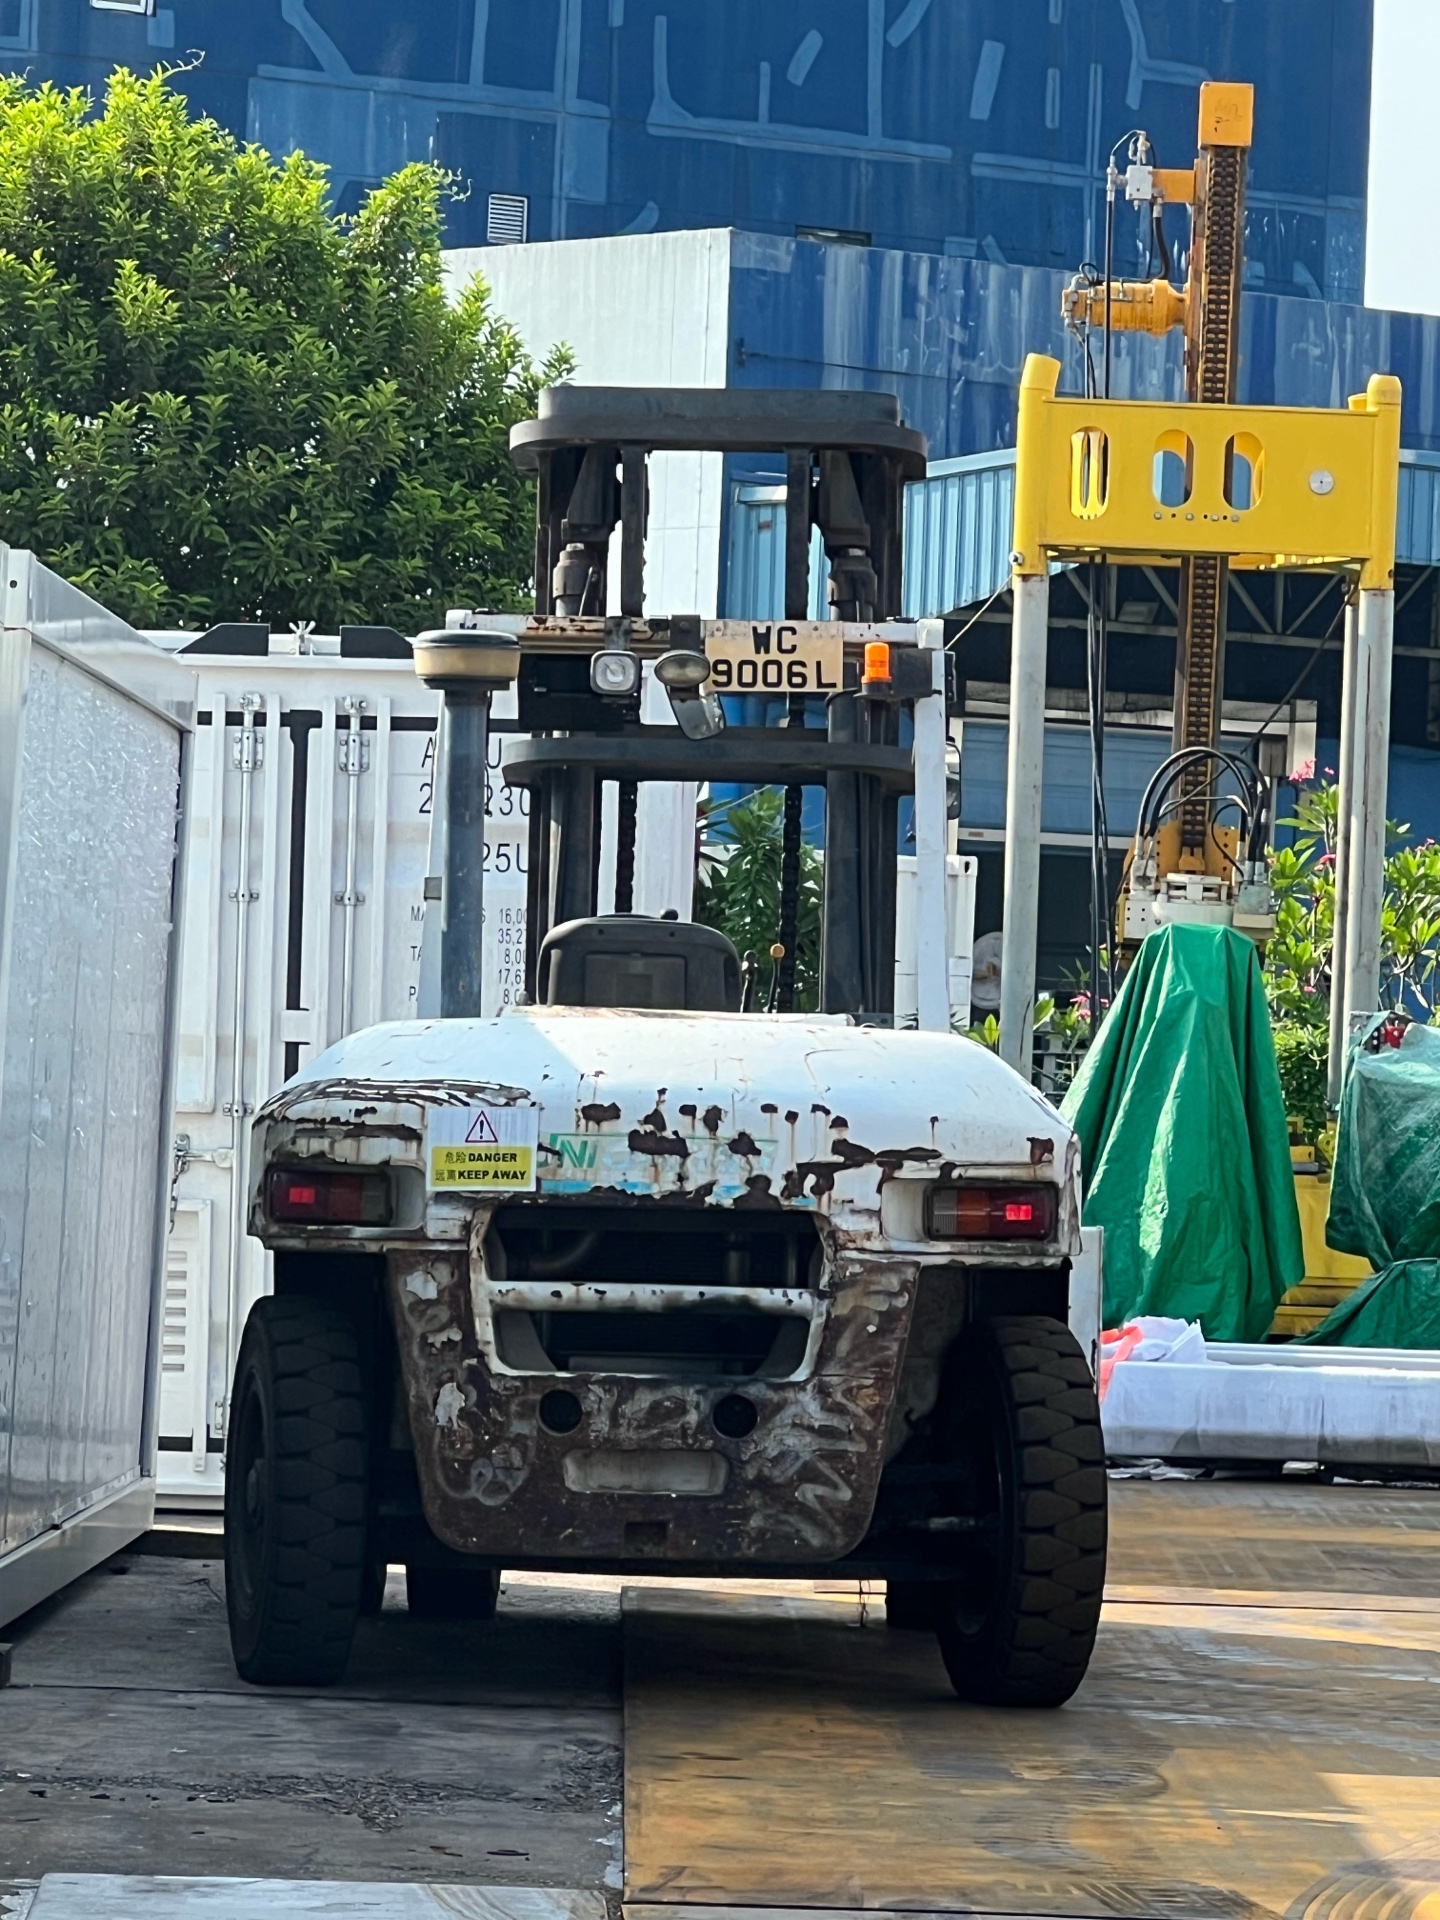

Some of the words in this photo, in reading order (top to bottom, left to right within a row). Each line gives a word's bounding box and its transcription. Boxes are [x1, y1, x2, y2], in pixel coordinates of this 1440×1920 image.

[752, 625, 798, 655] WC
[711, 658, 837, 689] 9006L
[468, 1152, 518, 1163] DANGER
[458, 1169, 490, 1180] KEEP
[492, 1169, 527, 1180] AWAY
